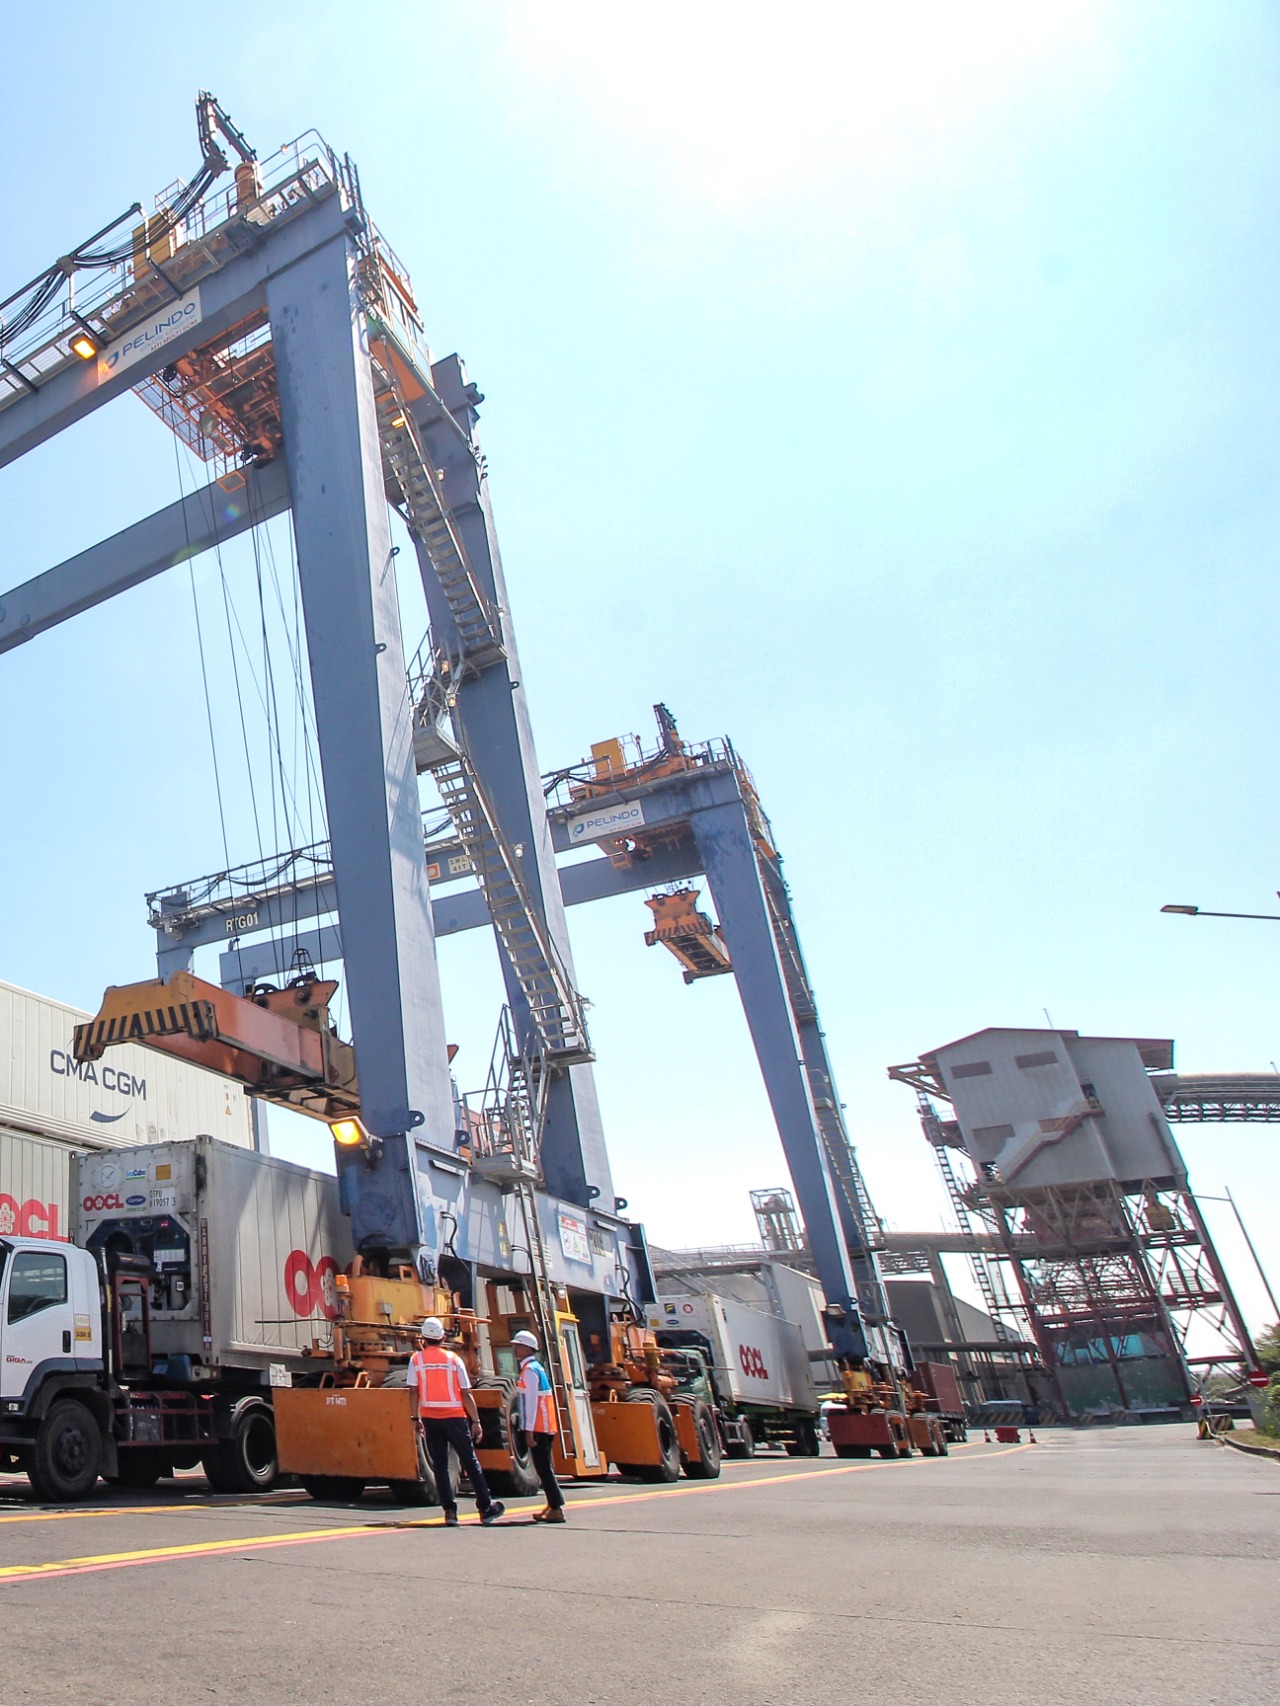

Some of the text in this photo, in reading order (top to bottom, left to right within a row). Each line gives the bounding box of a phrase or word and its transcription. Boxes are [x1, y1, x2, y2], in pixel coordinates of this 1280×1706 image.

[122, 302, 196, 356] PELINDO
[586, 808, 639, 829] PELINDO
[50, 1049, 147, 1101] CMA CGM
[83, 1193, 125, 1212] OOCL
[739, 1343, 769, 1380] OOCL
